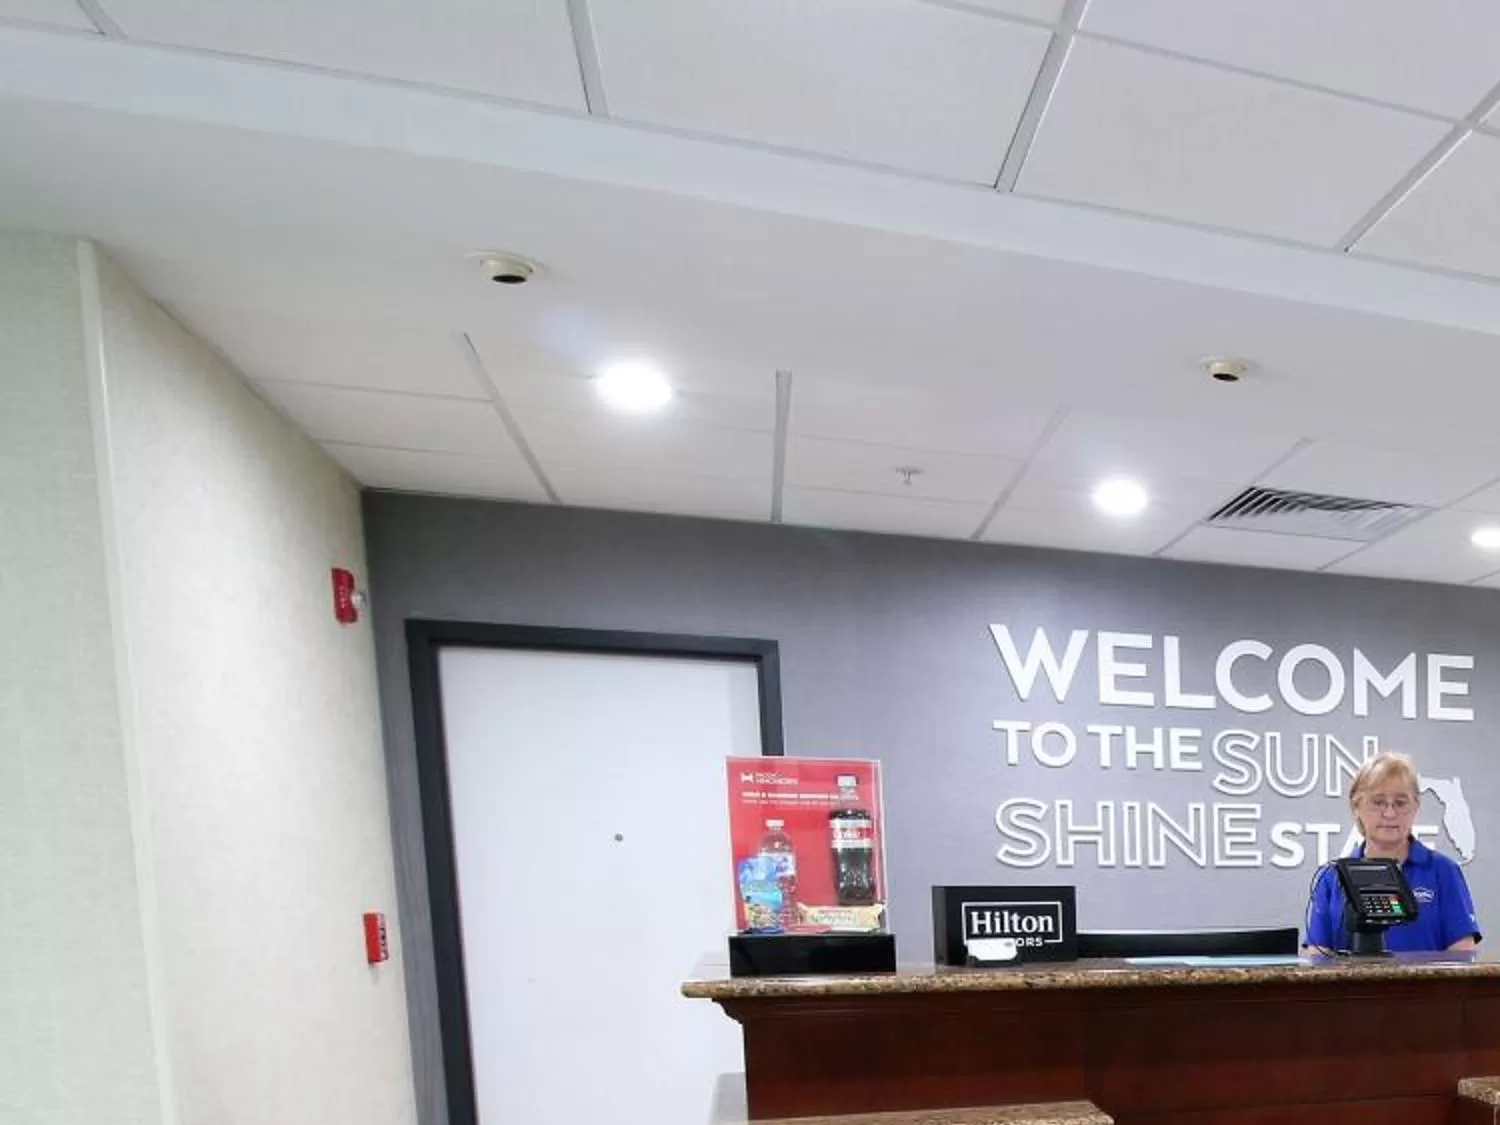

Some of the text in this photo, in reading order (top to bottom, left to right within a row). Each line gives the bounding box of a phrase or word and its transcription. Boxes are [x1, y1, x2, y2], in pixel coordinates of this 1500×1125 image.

[989, 623, 1475, 721] WELCOME
[993, 720, 1379, 798] TO THE SUN
[995, 798, 1264, 868] SHINE
[970, 910, 1054, 935] Hilton
